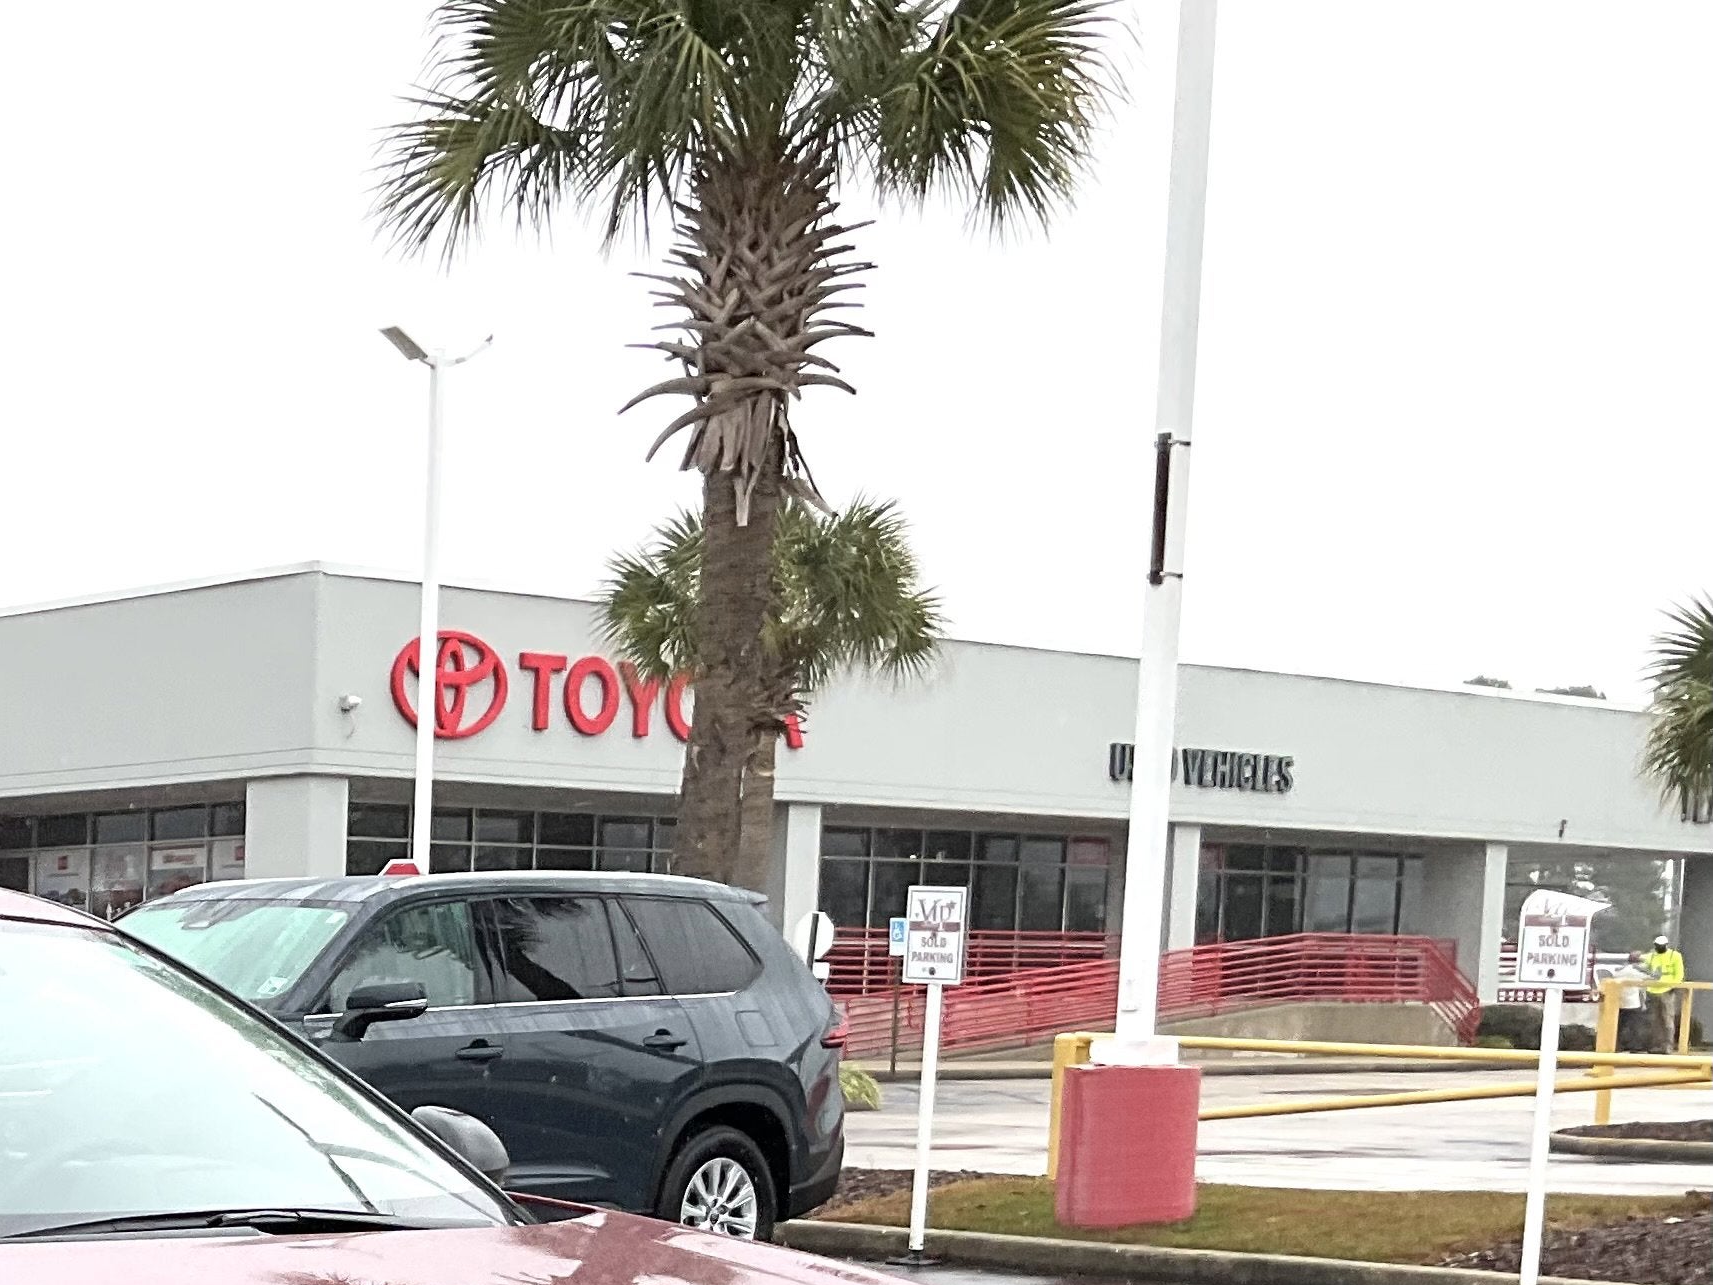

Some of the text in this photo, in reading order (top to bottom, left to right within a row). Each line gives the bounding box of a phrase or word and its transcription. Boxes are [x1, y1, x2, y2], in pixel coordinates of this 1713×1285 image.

[1182, 748, 1294, 793] VEHICLES
[920, 936, 947, 948] SOLD
[1538, 934, 1570, 948] SOLD
[911, 951, 955, 964] PARKING
[1527, 952, 1578, 966] PARKING
